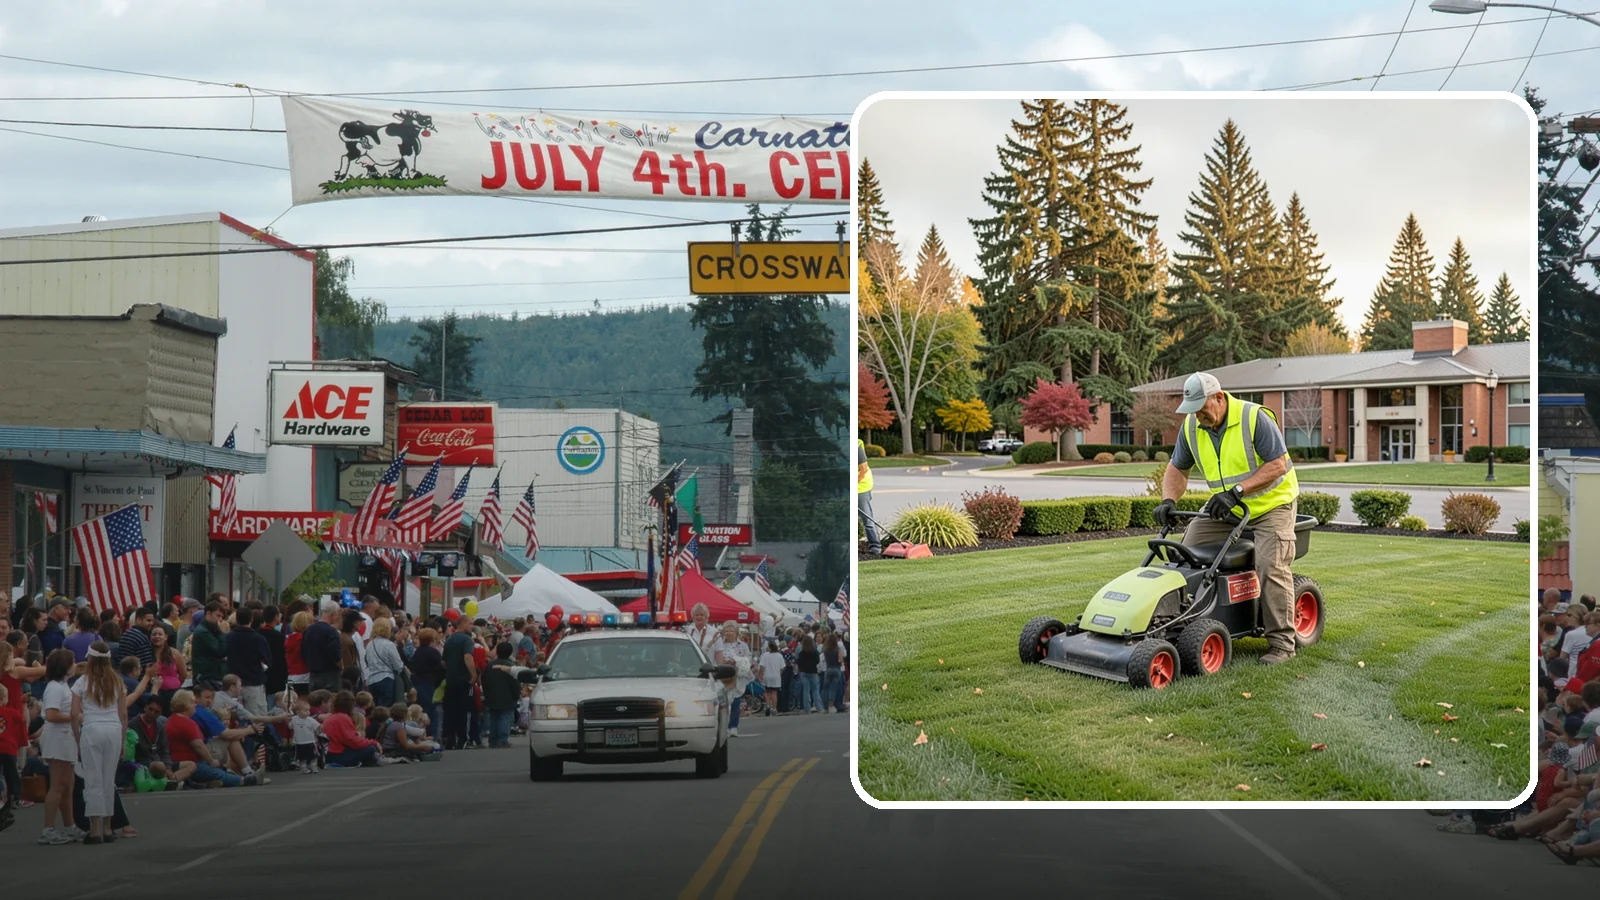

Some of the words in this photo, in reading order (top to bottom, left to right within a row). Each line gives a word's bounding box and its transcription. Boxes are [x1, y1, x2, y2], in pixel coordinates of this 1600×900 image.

[481, 141, 606, 193] JULY
[632, 149, 747, 199] 4th.
[697, 253, 850, 280] CROSSWA
[283, 380, 373, 420] ACE
[405, 409, 452, 422] CEDAR
[284, 421, 371, 438] Hardware
[416, 428, 477, 447] Coca-Cola
[353, 467, 385, 480] Simpl
[95, 485, 124, 494] Vincent
[126, 486, 136, 494] de
[138, 486, 155, 495] Paul
[212, 516, 331, 535] HARDARE
[688, 526, 741, 535] CRNATION
[699, 535, 730, 543] GLASS
